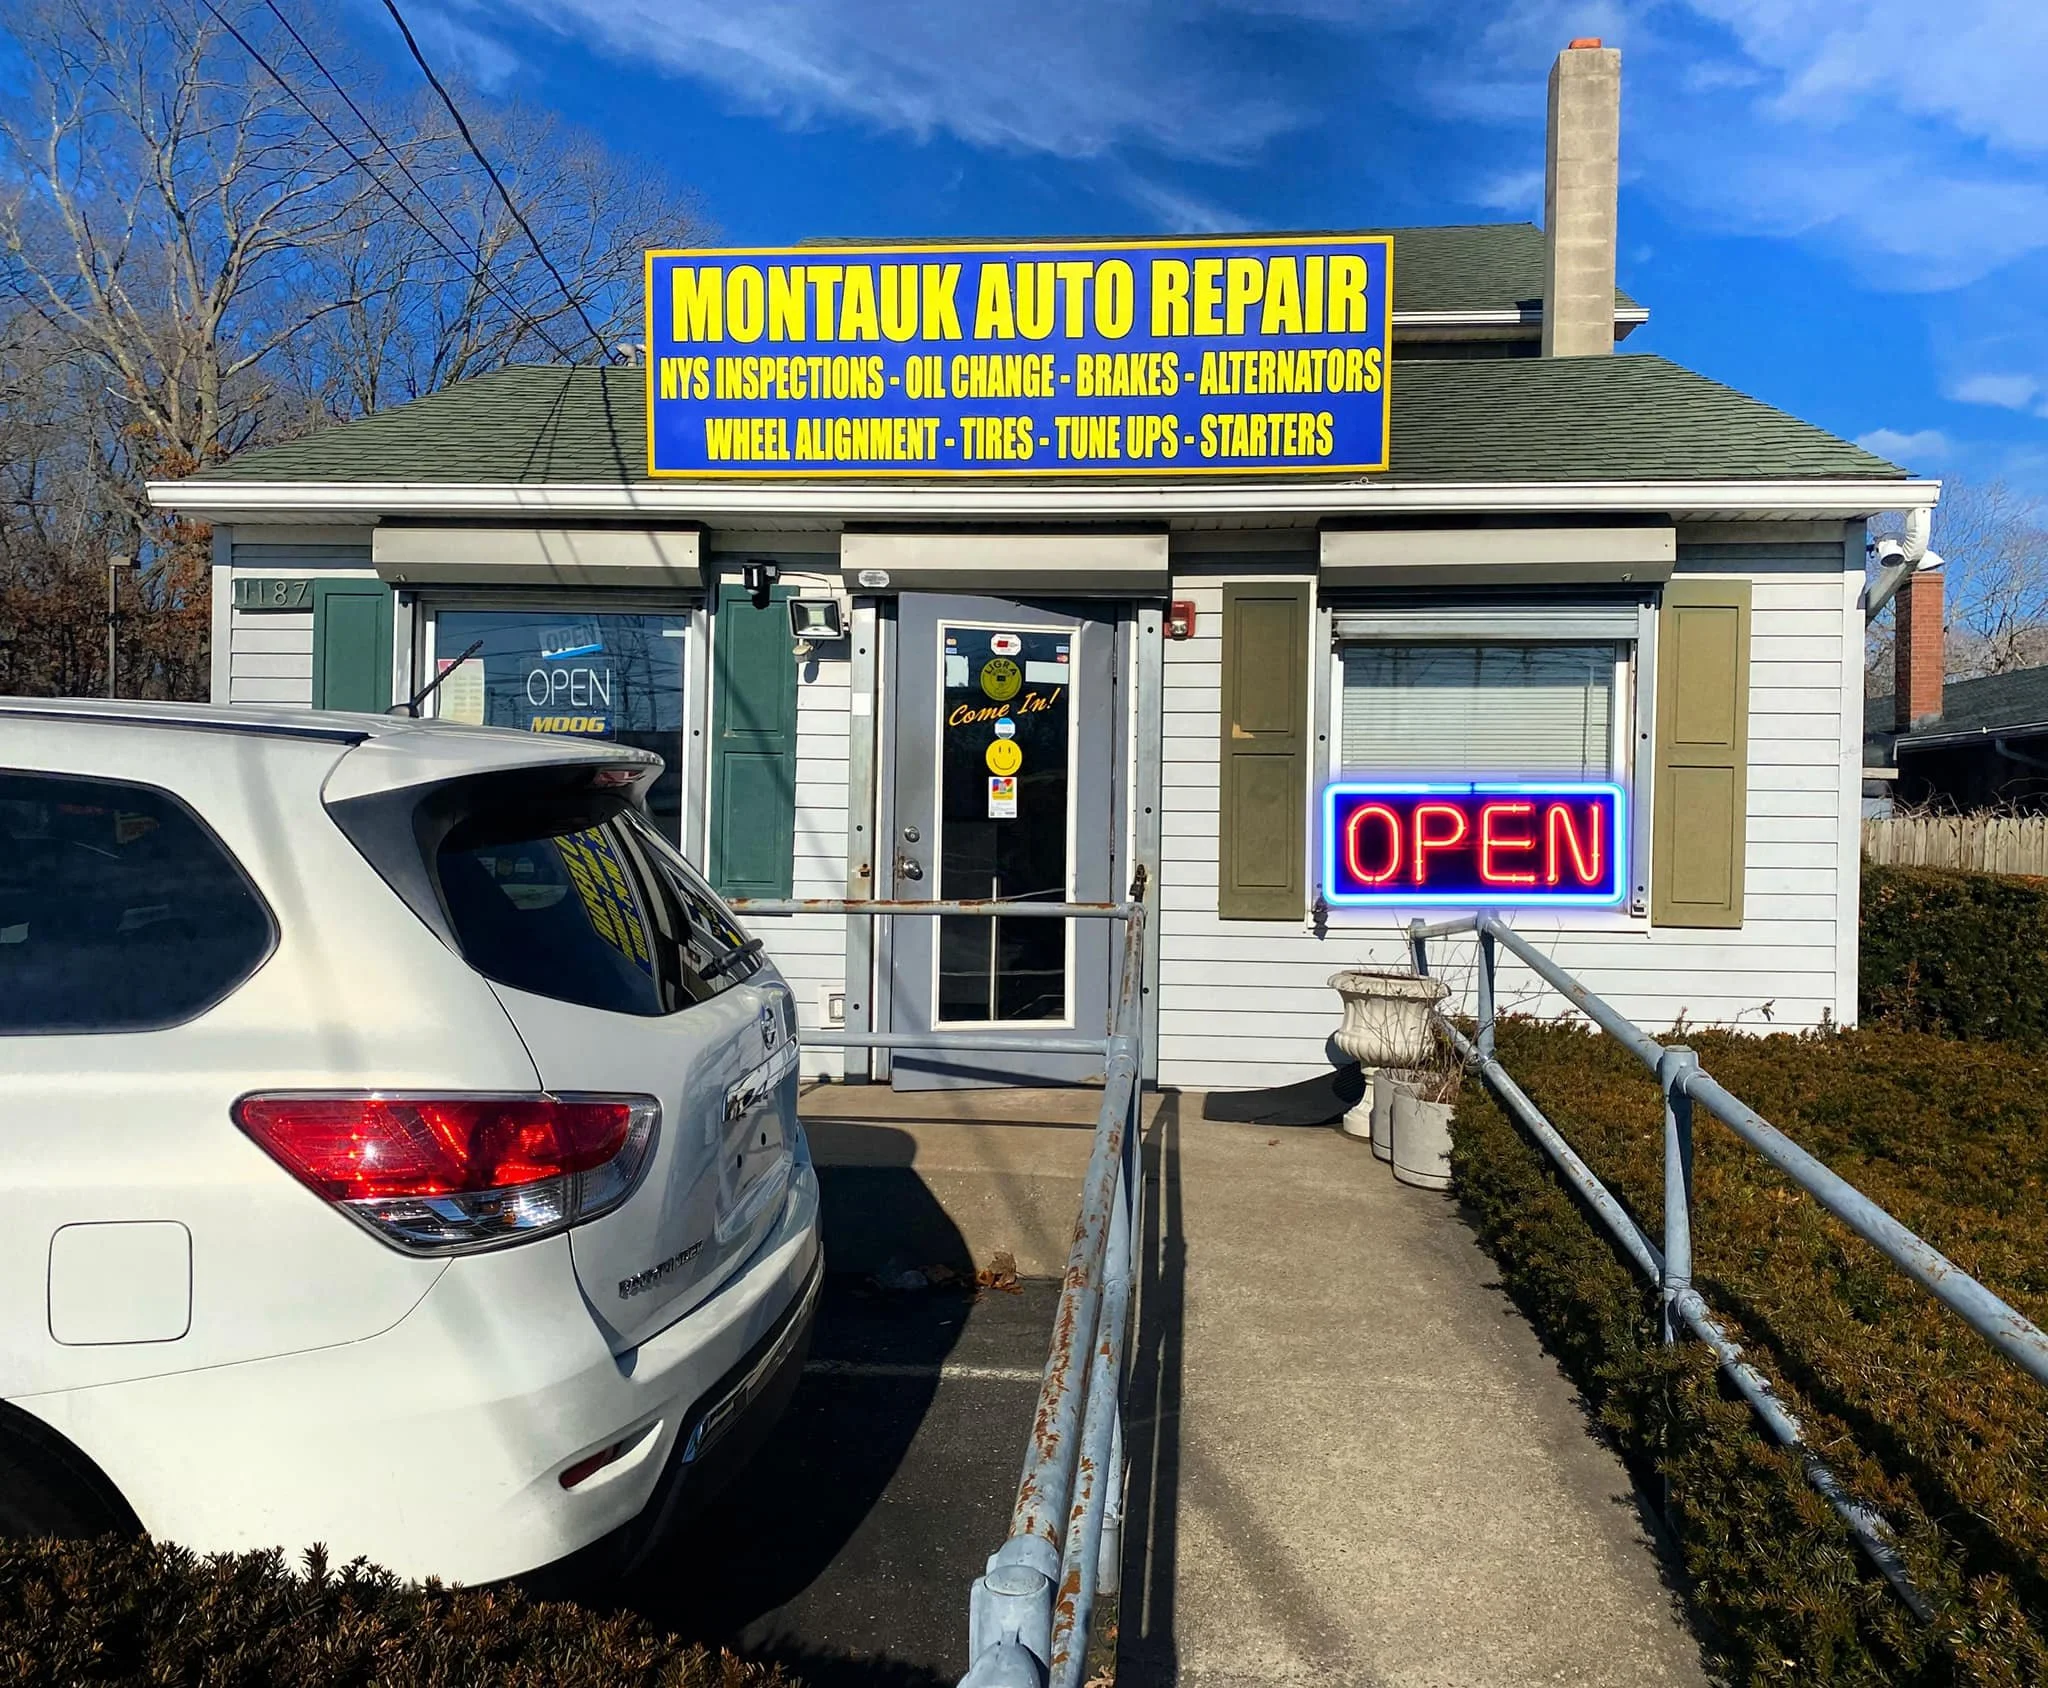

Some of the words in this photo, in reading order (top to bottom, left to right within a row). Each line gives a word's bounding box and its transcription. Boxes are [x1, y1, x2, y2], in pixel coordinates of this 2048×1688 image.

[672, 264, 962, 343] MONTAUK
[974, 259, 1134, 340] AUTO
[1151, 255, 1368, 337] REPAIR
[660, 356, 709, 399] NYS
[715, 355, 885, 400] INSPECTIONS
[905, 355, 945, 400] OIL
[951, 354, 1054, 398] CHANGE
[1076, 351, 1179, 397] BRAKES
[1199, 347, 1382, 395] ALTERNATORS
[705, 418, 789, 461] WHEEL
[794, 417, 939, 461] ALIGNMENT
[959, 415, 1034, 460] TIRES
[1054, 415, 1121, 460] TUNE
[1126, 415, 1179, 459] UPS
[1200, 411, 1333, 458] STARTERS
[243, 579, 309, 606] 1187
[546, 623, 599, 653] OPEN
[526, 668, 611, 707] OPEN
[949, 703, 1011, 727] Come
[1017, 687, 1061, 715] In!
[530, 716, 606, 733] MOOG
[1345, 803, 1605, 886] OPEN
